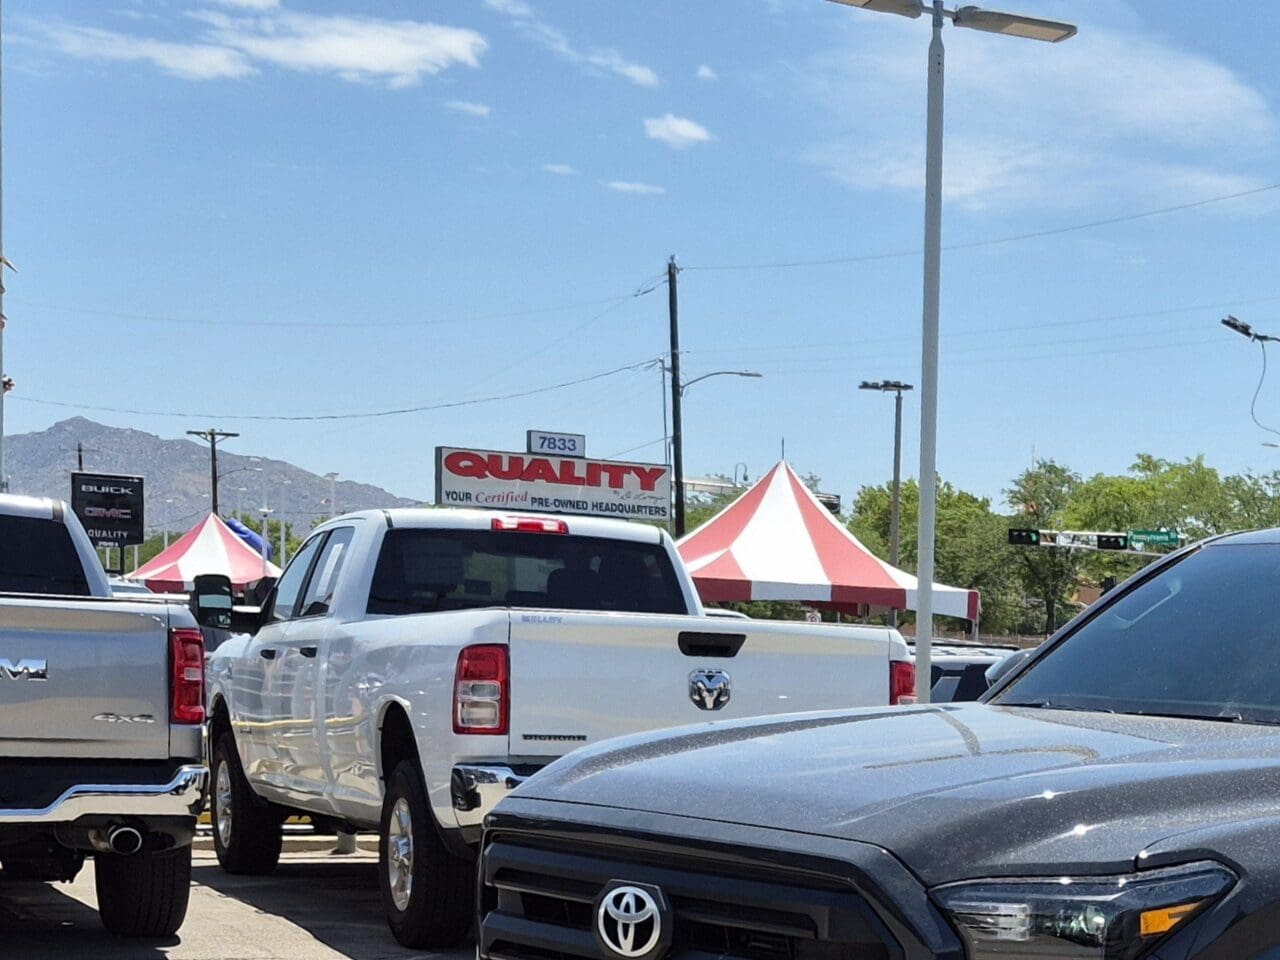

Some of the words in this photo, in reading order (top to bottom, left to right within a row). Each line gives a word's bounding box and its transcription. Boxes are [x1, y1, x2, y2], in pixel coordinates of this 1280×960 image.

[538, 436, 577, 451] 7833
[444, 451, 668, 492] QUALITY
[81, 484, 134, 494] BUICK
[445, 490, 472, 502] YOUR
[475, 491, 529, 505] Certified
[531, 496, 589, 511] PRE-OWNED
[591, 501, 668, 517] HEADQUARTERS
[84, 507, 131, 518] GMC
[88, 529, 128, 539] QUALITY
